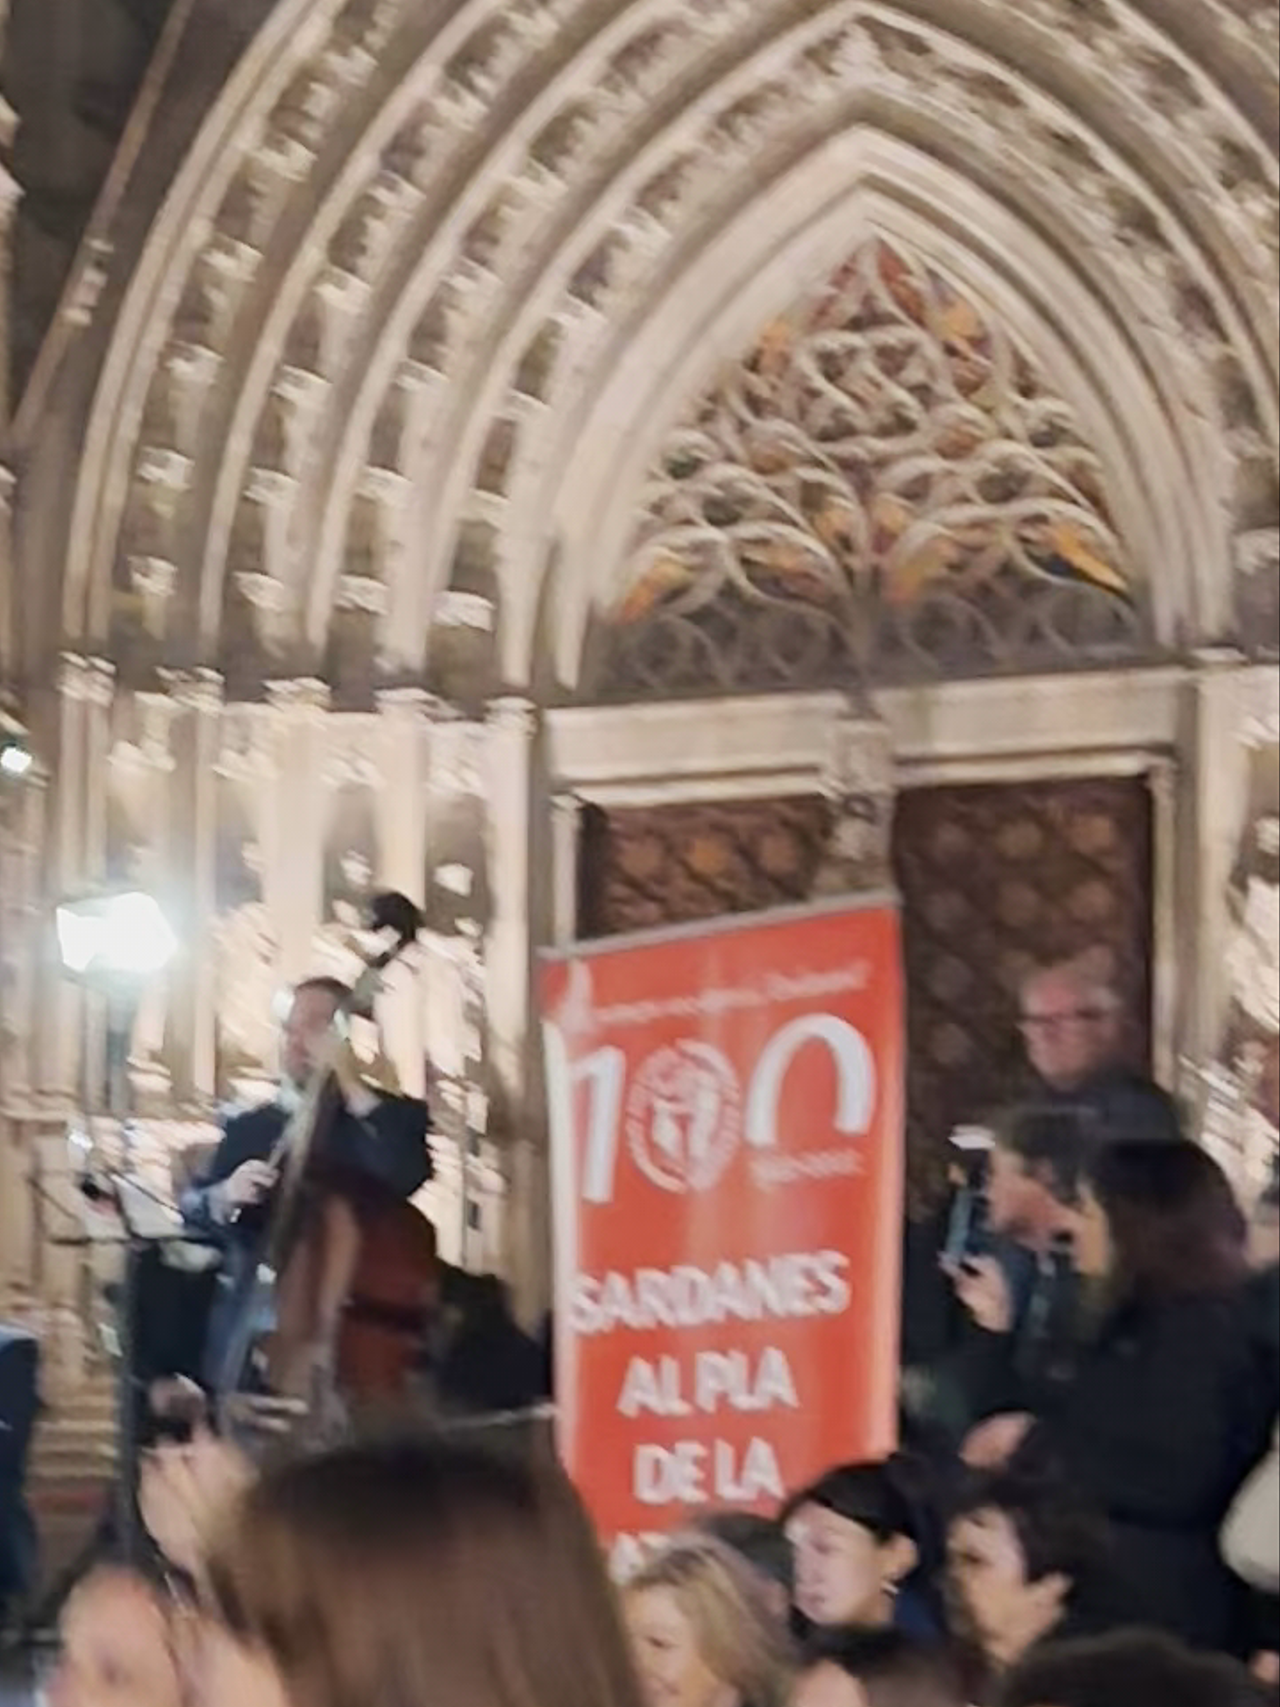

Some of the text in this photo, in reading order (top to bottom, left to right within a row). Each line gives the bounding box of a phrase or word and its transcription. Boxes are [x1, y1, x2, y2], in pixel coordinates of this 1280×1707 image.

[570, 1251, 851, 1335] SARDANES
[615, 1346, 800, 1418] AL PLA
[632, 1436, 786, 1505] DE LA
